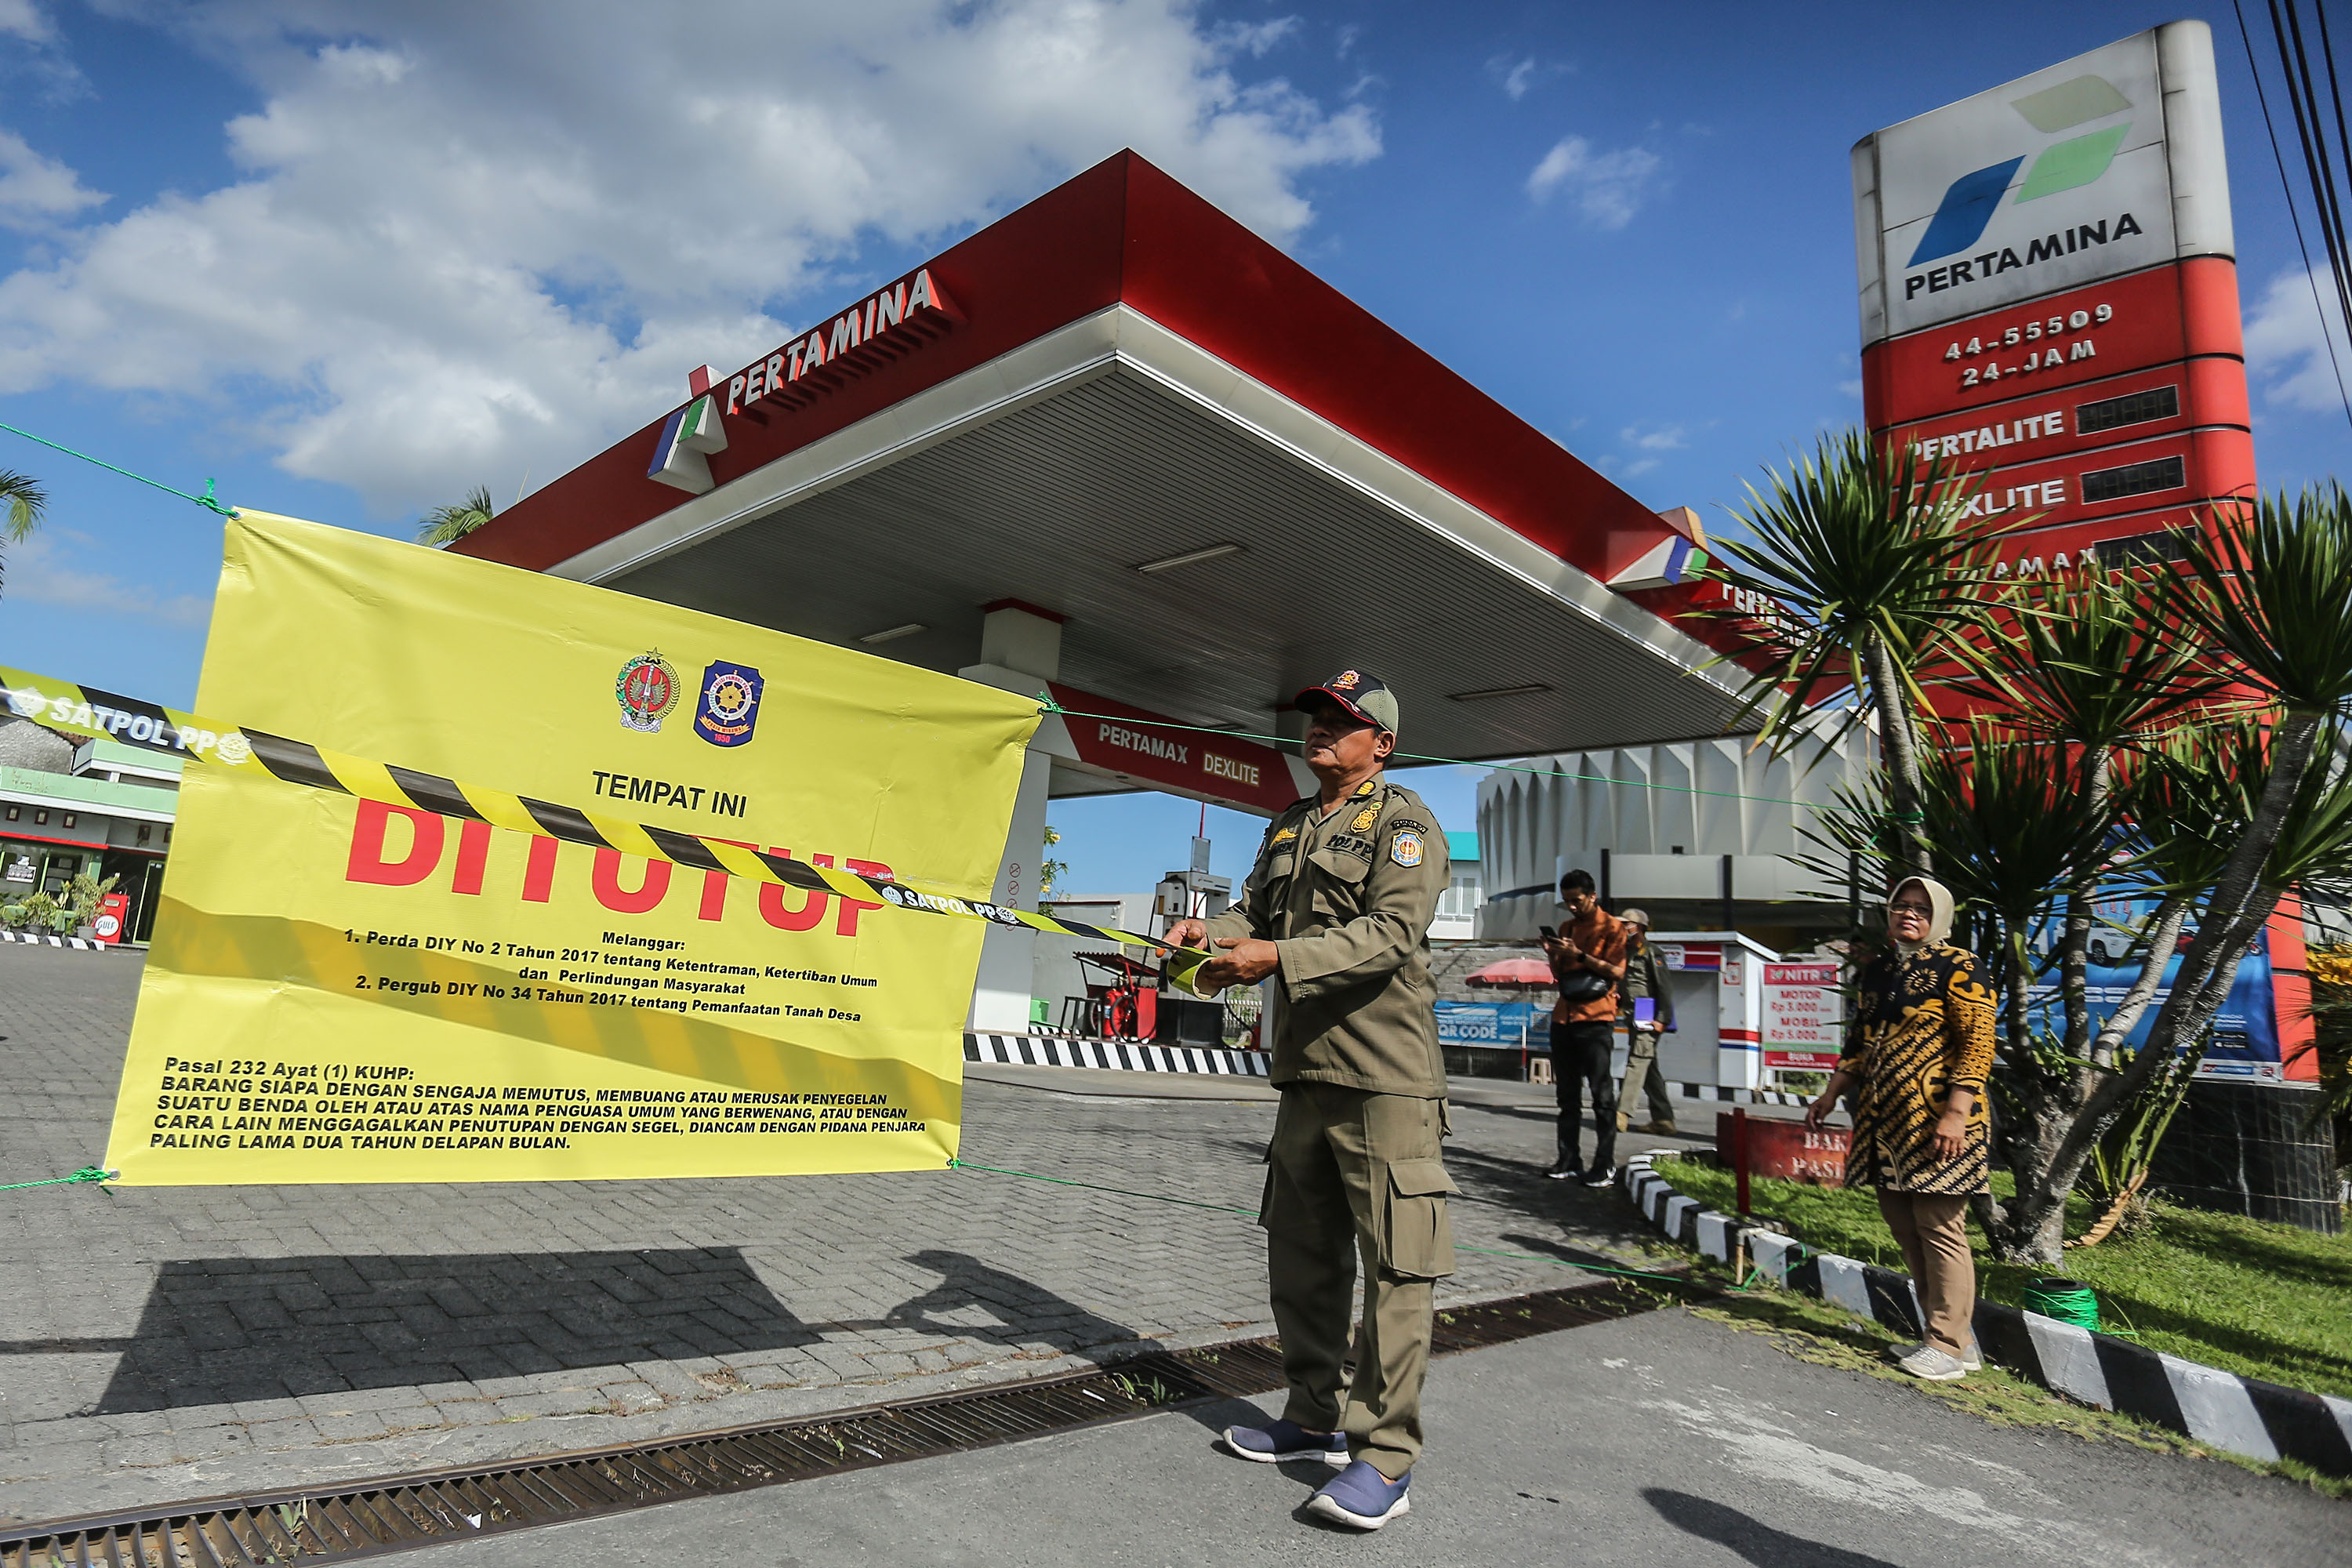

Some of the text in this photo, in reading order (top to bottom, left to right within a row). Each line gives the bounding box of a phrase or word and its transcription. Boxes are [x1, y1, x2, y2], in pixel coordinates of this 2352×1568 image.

[1905, 212, 2143, 300] PERTAMINA
[727, 268, 942, 416] PERTAMINA
[1945, 303, 2113, 361] 44-55509
[1962, 339, 2096, 387] 24-JAM
[1905, 411, 2064, 461] PERTALITE
[49, 696, 217, 753] SATPOL PP
[715, 733, 731, 743] 1950
[1098, 723, 1259, 785] PERTAMAX DEXLITE
[593, 770, 747, 818] TEMPAT INI
[1328, 834, 1374, 857] POL PP
[345, 797, 895, 936] DITUTUP
[904, 890, 996, 920] SATPOL PP
[98, 921, 115, 931] GULF
[602, 931, 686, 951] Melanggar:
[344, 928, 878, 988] 1. Perda DIY No 2 Tahun 2017 tentang Ketentraman, Ketertiban Umum
[518, 967, 746, 996] dan Perlindungan Masyarakat
[355, 975, 862, 1022] 2. Pergub DIY No 34 Tahun 2017 tentang Pemanfaatan Tanah Desa
[1770, 1001, 1785, 1013] Rp
[1788, 1002, 1817, 1012] 3.000
[1780, 990, 1822, 1000] MOTOR
[1439, 1024, 1497, 1039] QR CODE
[1770, 1029, 1817, 1040] Rp 5.000
[1780, 1018, 1822, 1027] MOBIL
[165, 1057, 414, 1080] Pasal 232 Ayat (1) KUHP:
[162, 1076, 887, 1105] BARANG SIAPA DENGAN SENGAJA MEMUTUS, MEMBUANG ATAU MERUSAK PENYEGELAN
[158, 1095, 908, 1121] SUATU BENDA OLEH ATAU ATAS NAMA PENGUASA UMUM YANG BERWENANG, ATAU DENGAN
[154, 1115, 926, 1134] CARA LAIN MENGGAGALKAN PENUTUPAN DENGAN SEGEL, DIANCAM DENGAN PIDANA PENJARA
[151, 1134, 571, 1149] PALING LAMA DUA TAHUN DELAPAN BULAN.
[1804, 1131, 1846, 1152] BAK
[1791, 1156, 1841, 1179] PASI
